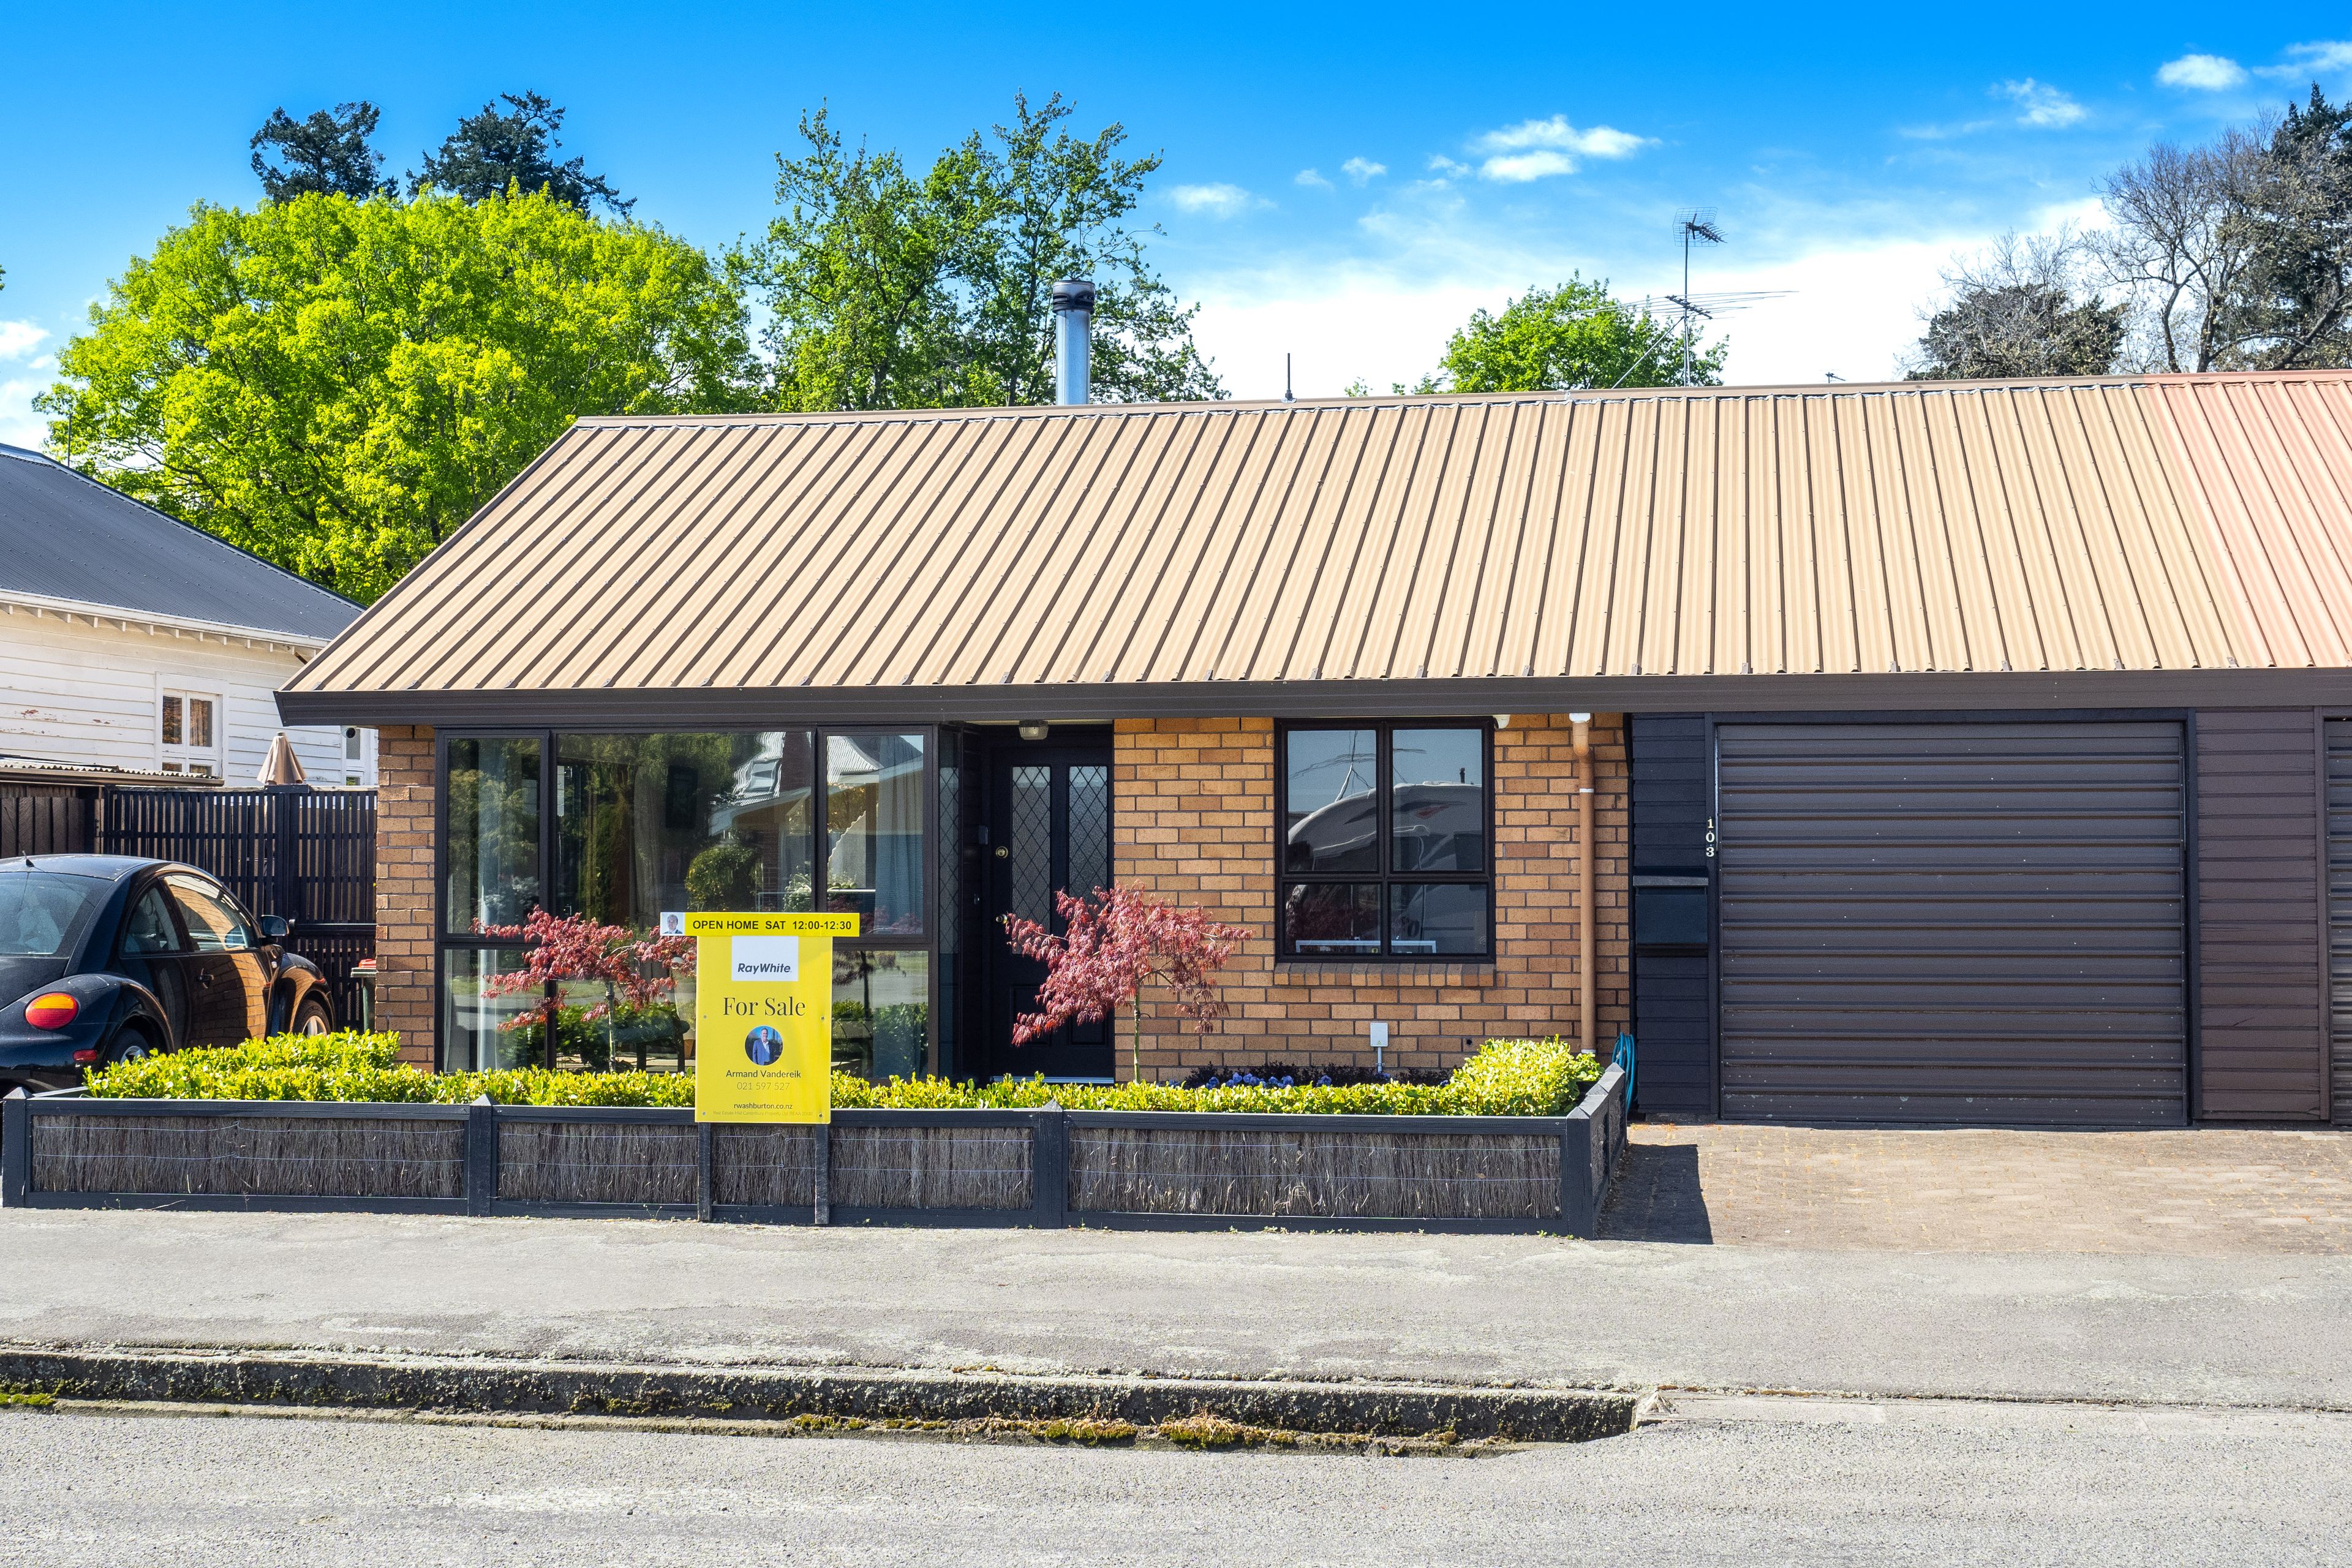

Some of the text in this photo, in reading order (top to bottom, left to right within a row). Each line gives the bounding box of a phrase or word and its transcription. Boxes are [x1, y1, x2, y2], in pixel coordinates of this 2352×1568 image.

[1705, 818, 1715, 857] 103
[693, 921, 851, 930] OPEN HOME SAT 12:00-12:30
[723, 996, 805, 1016] For Sale
[737, 1082, 753, 1090] 021
